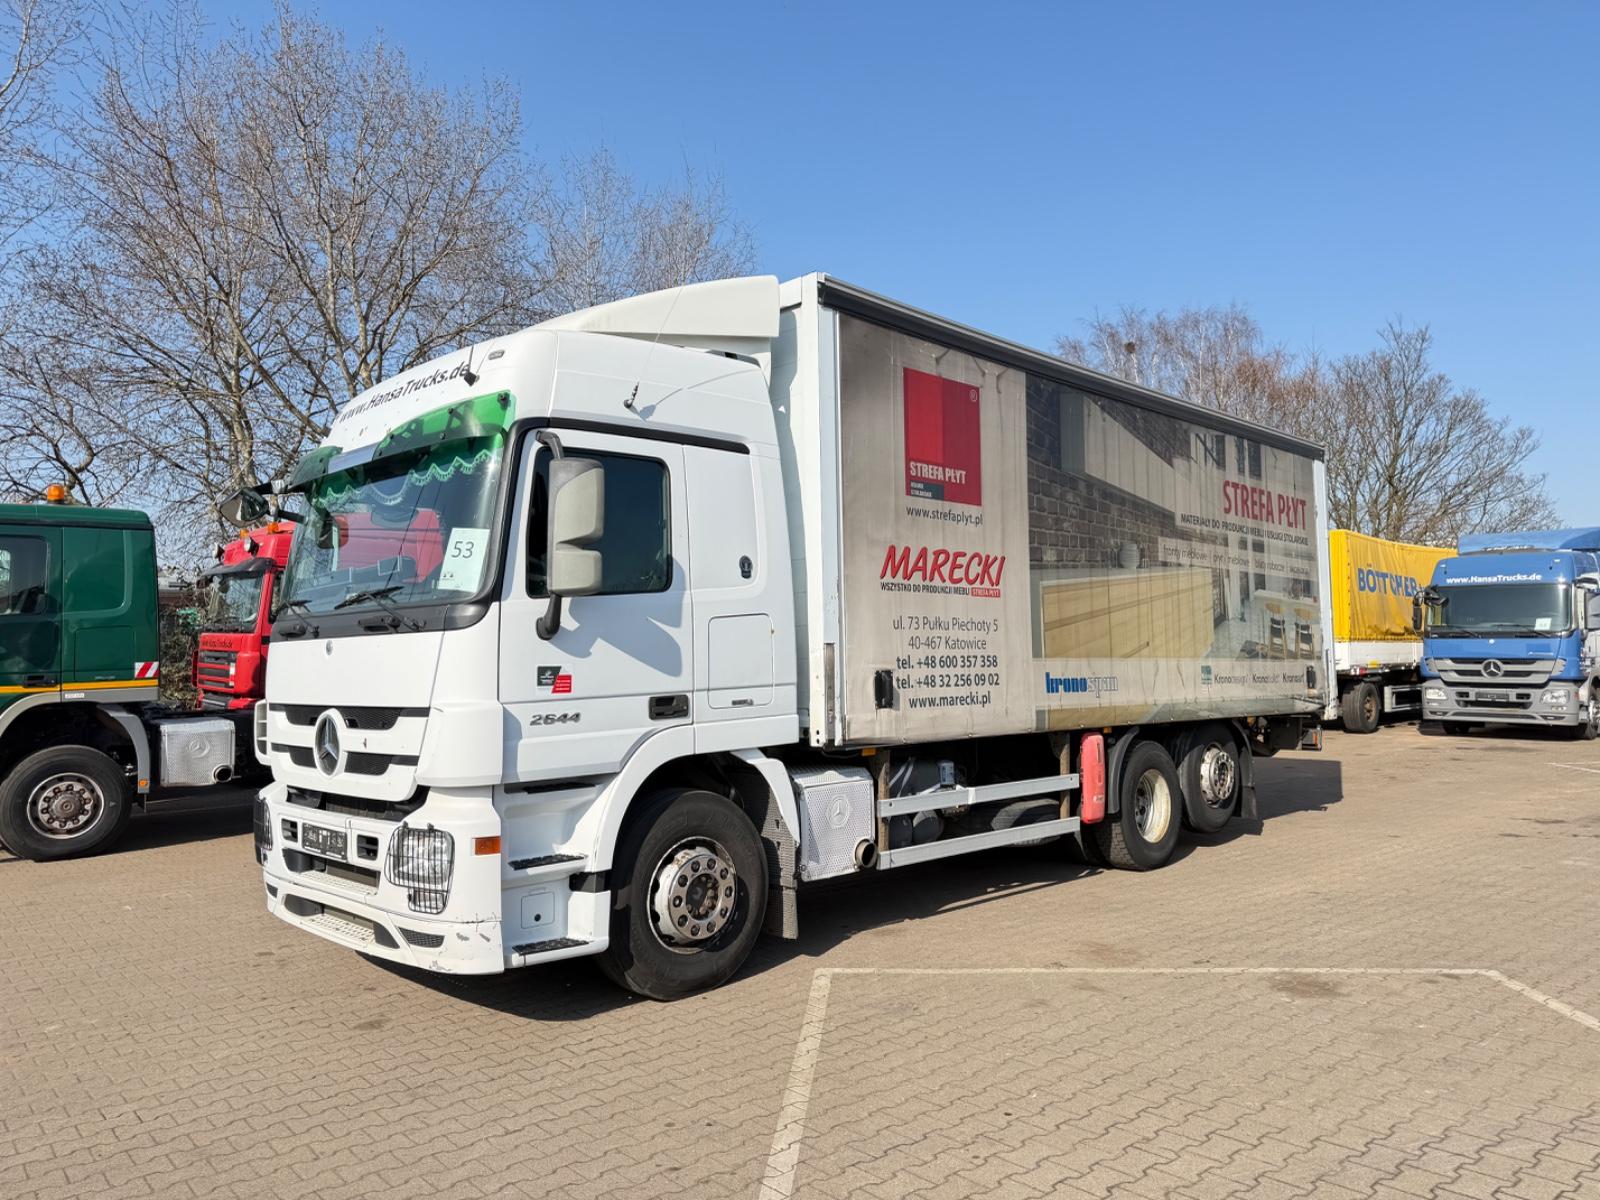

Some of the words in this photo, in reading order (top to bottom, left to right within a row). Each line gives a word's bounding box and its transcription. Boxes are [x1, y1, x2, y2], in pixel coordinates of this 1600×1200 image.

[910, 461, 944, 480] STREFA
[945, 467, 966, 484] PŁYT
[1222, 480, 1274, 524] STREFA
[1277, 494, 1307, 530] PŁYT
[906, 506, 983, 527] www.strefaplyt.pl
[1212, 519, 1220, 529] DO
[451, 541, 474, 558] 53
[879, 544, 1006, 587] MARECKI
[1446, 573, 1542, 584] www.HansaTrucks.de
[881, 582, 911, 592] WSZYSTKO
[912, 584, 921, 592] DO
[893, 615, 905, 630] ul.
[908, 616, 920, 630] 73
[922, 616, 949, 631] Pułku
[952, 617, 991, 634] Piechoty
[993, 619, 998, 632] 5
[908, 636, 942, 650] 40-467
[945, 636, 987, 650] Katowice
[896, 654, 914, 669] tel.
[916, 655, 936, 669] +48
[939, 655, 957, 668] 600
[960, 655, 977, 668] 357
[980, 655, 998, 668] 358
[896, 674, 914, 689] tel.
[916, 674, 936, 688] +48
[939, 674, 951, 687] 32
[954, 674, 972, 687] 256
[974, 673, 986, 686] 09
[988, 673, 1000, 686] 02
[908, 691, 991, 708] www.marecki.pl
[530, 712, 581, 726] 2644
